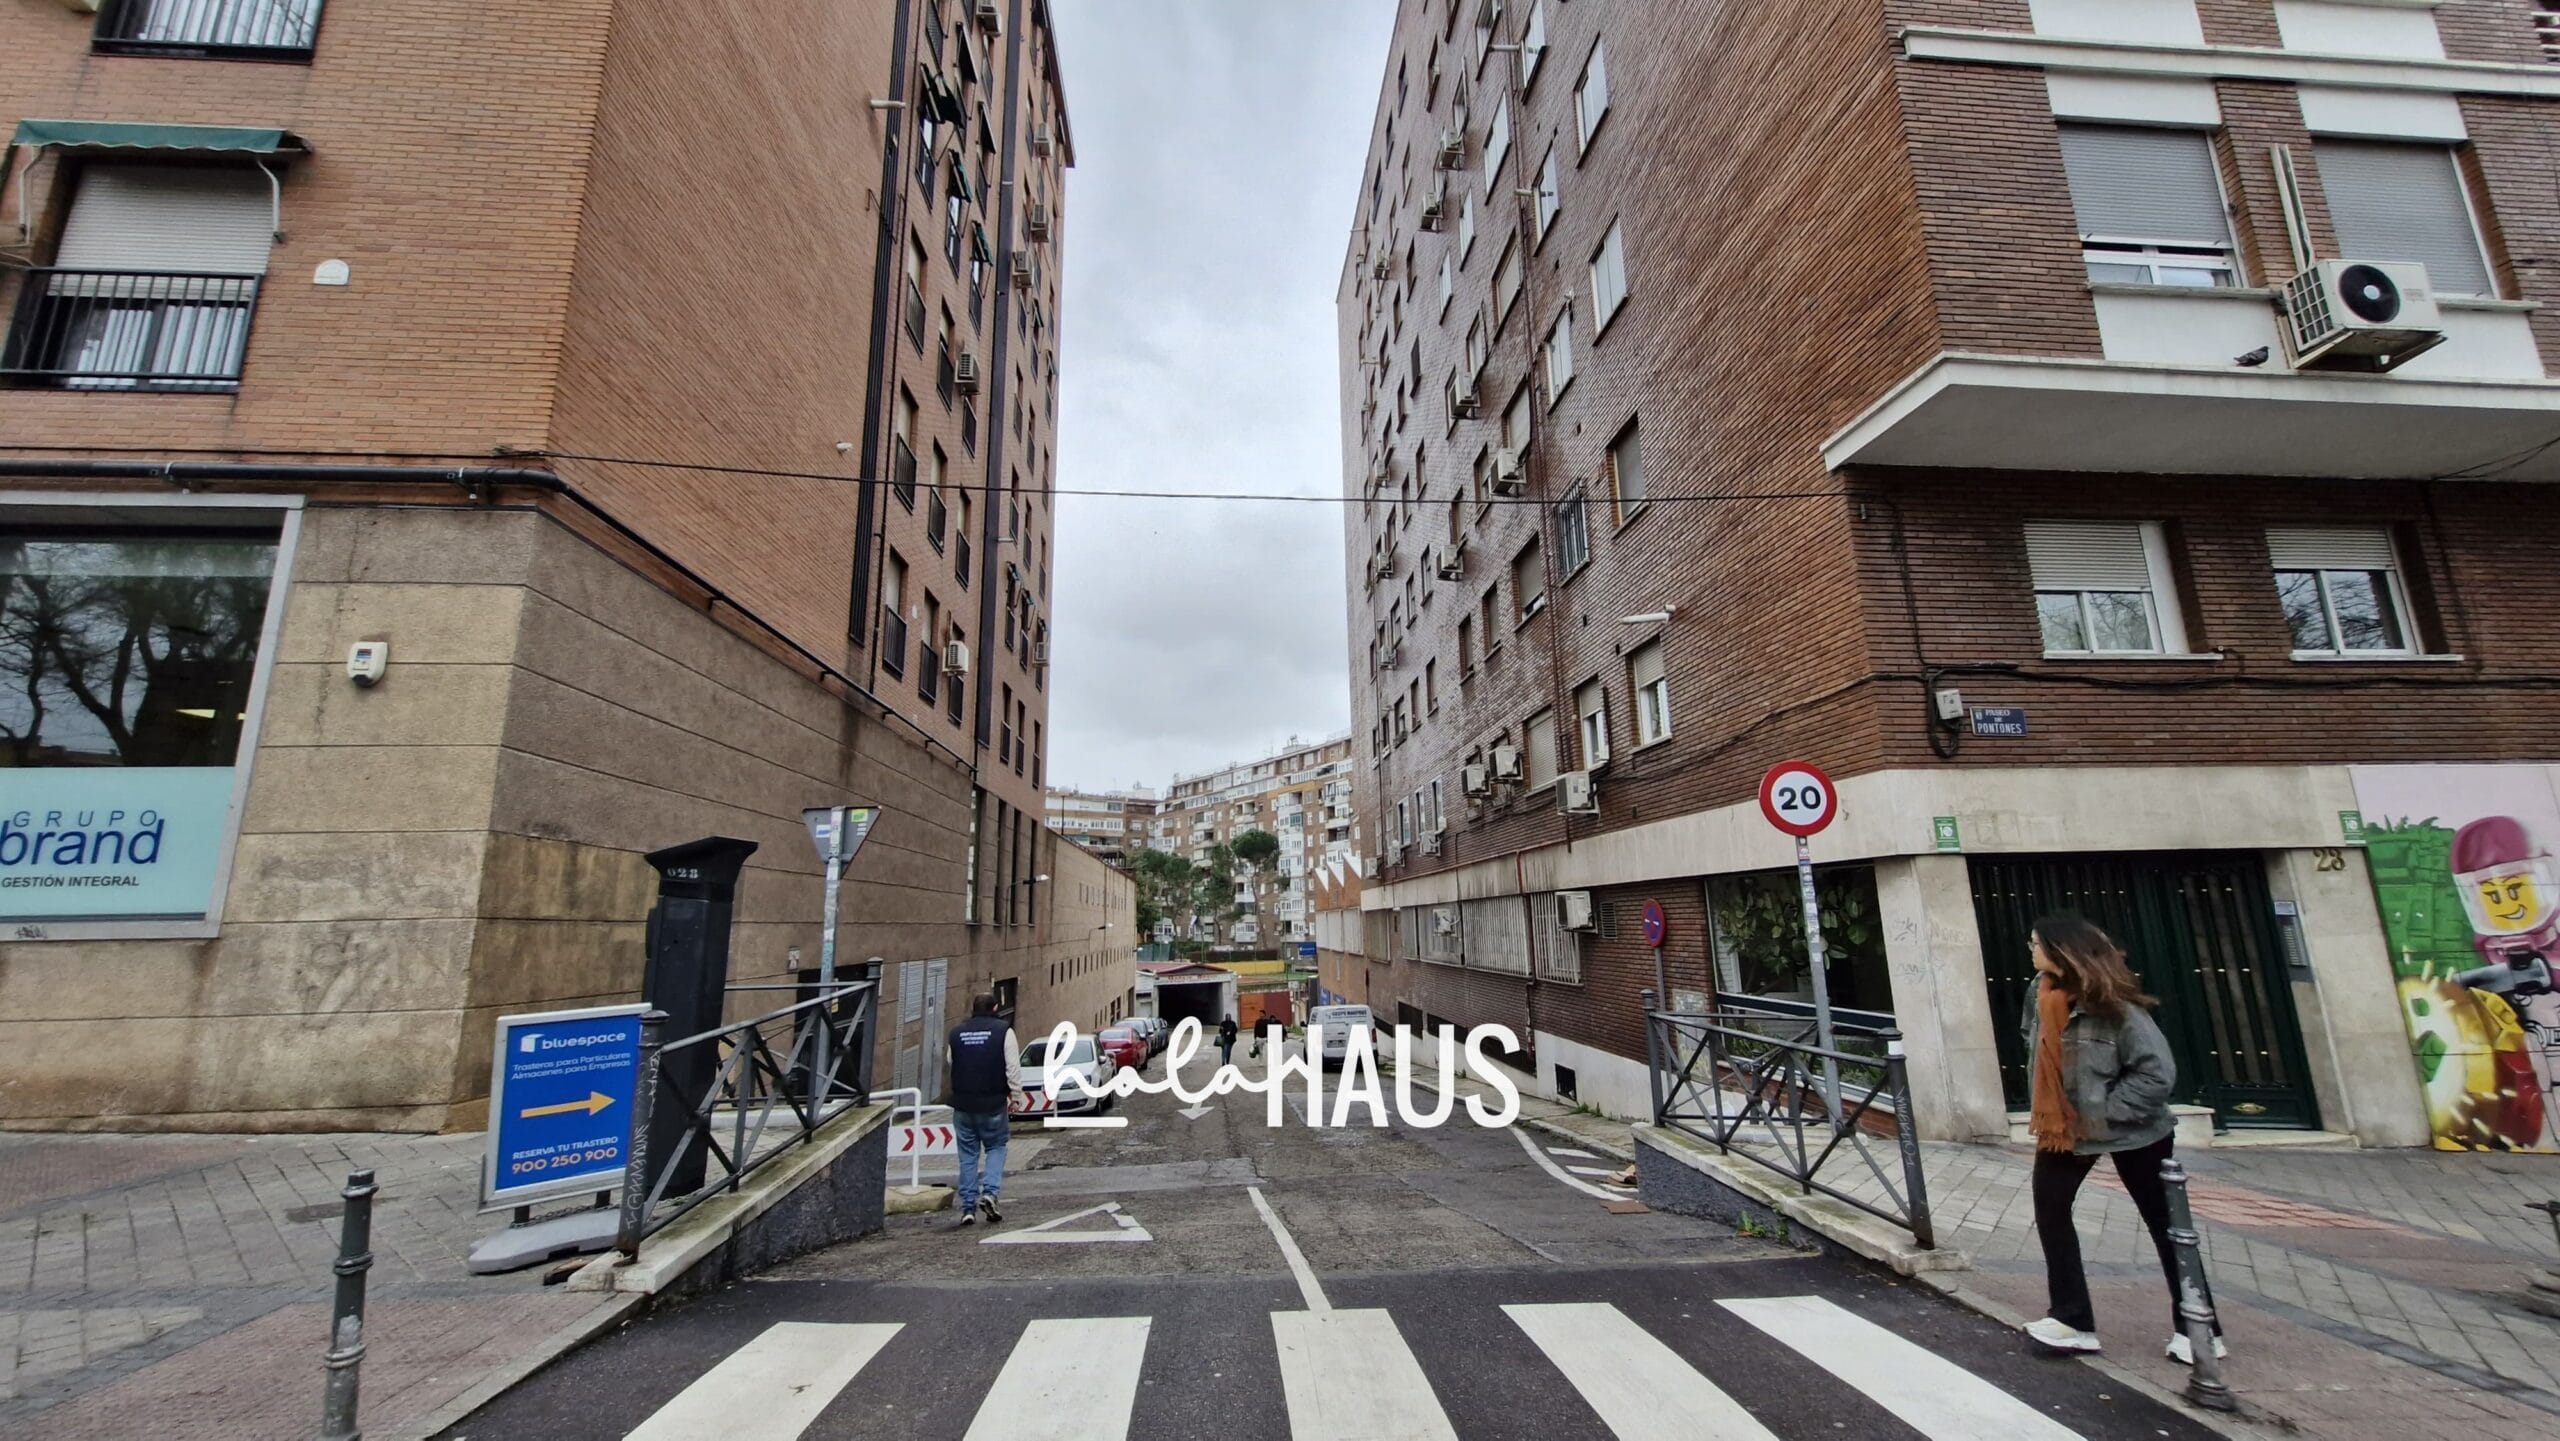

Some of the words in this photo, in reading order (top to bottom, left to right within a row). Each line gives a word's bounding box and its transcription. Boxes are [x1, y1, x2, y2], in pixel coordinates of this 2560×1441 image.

[1977, 722, 2023, 734] PONTONES
[1778, 786, 1821, 810] 20
[13, 810, 157, 828] GRUPO
[0, 819, 165, 866] brand
[2, 874, 65, 888] GESTIÓN
[68, 875, 140, 887] INTEGRAL
[542, 1032, 627, 1050] bluespace
[511, 1068, 563, 1080] Almacenes
[565, 1064, 587, 1075] para
[588, 1059, 631, 1071] Empresas
[513, 1061, 554, 1072] Trasteros
[556, 1058, 579, 1068] para
[580, 1052, 631, 1063] Particulares
[512, 1146, 555, 1160] RESERVA
[558, 1143, 570, 1153] TU
[572, 1136, 619, 1150] TRASTERO
[512, 1159, 548, 1175] 900
[551, 1153, 582, 1168] 250
[585, 1146, 618, 1162] 900
